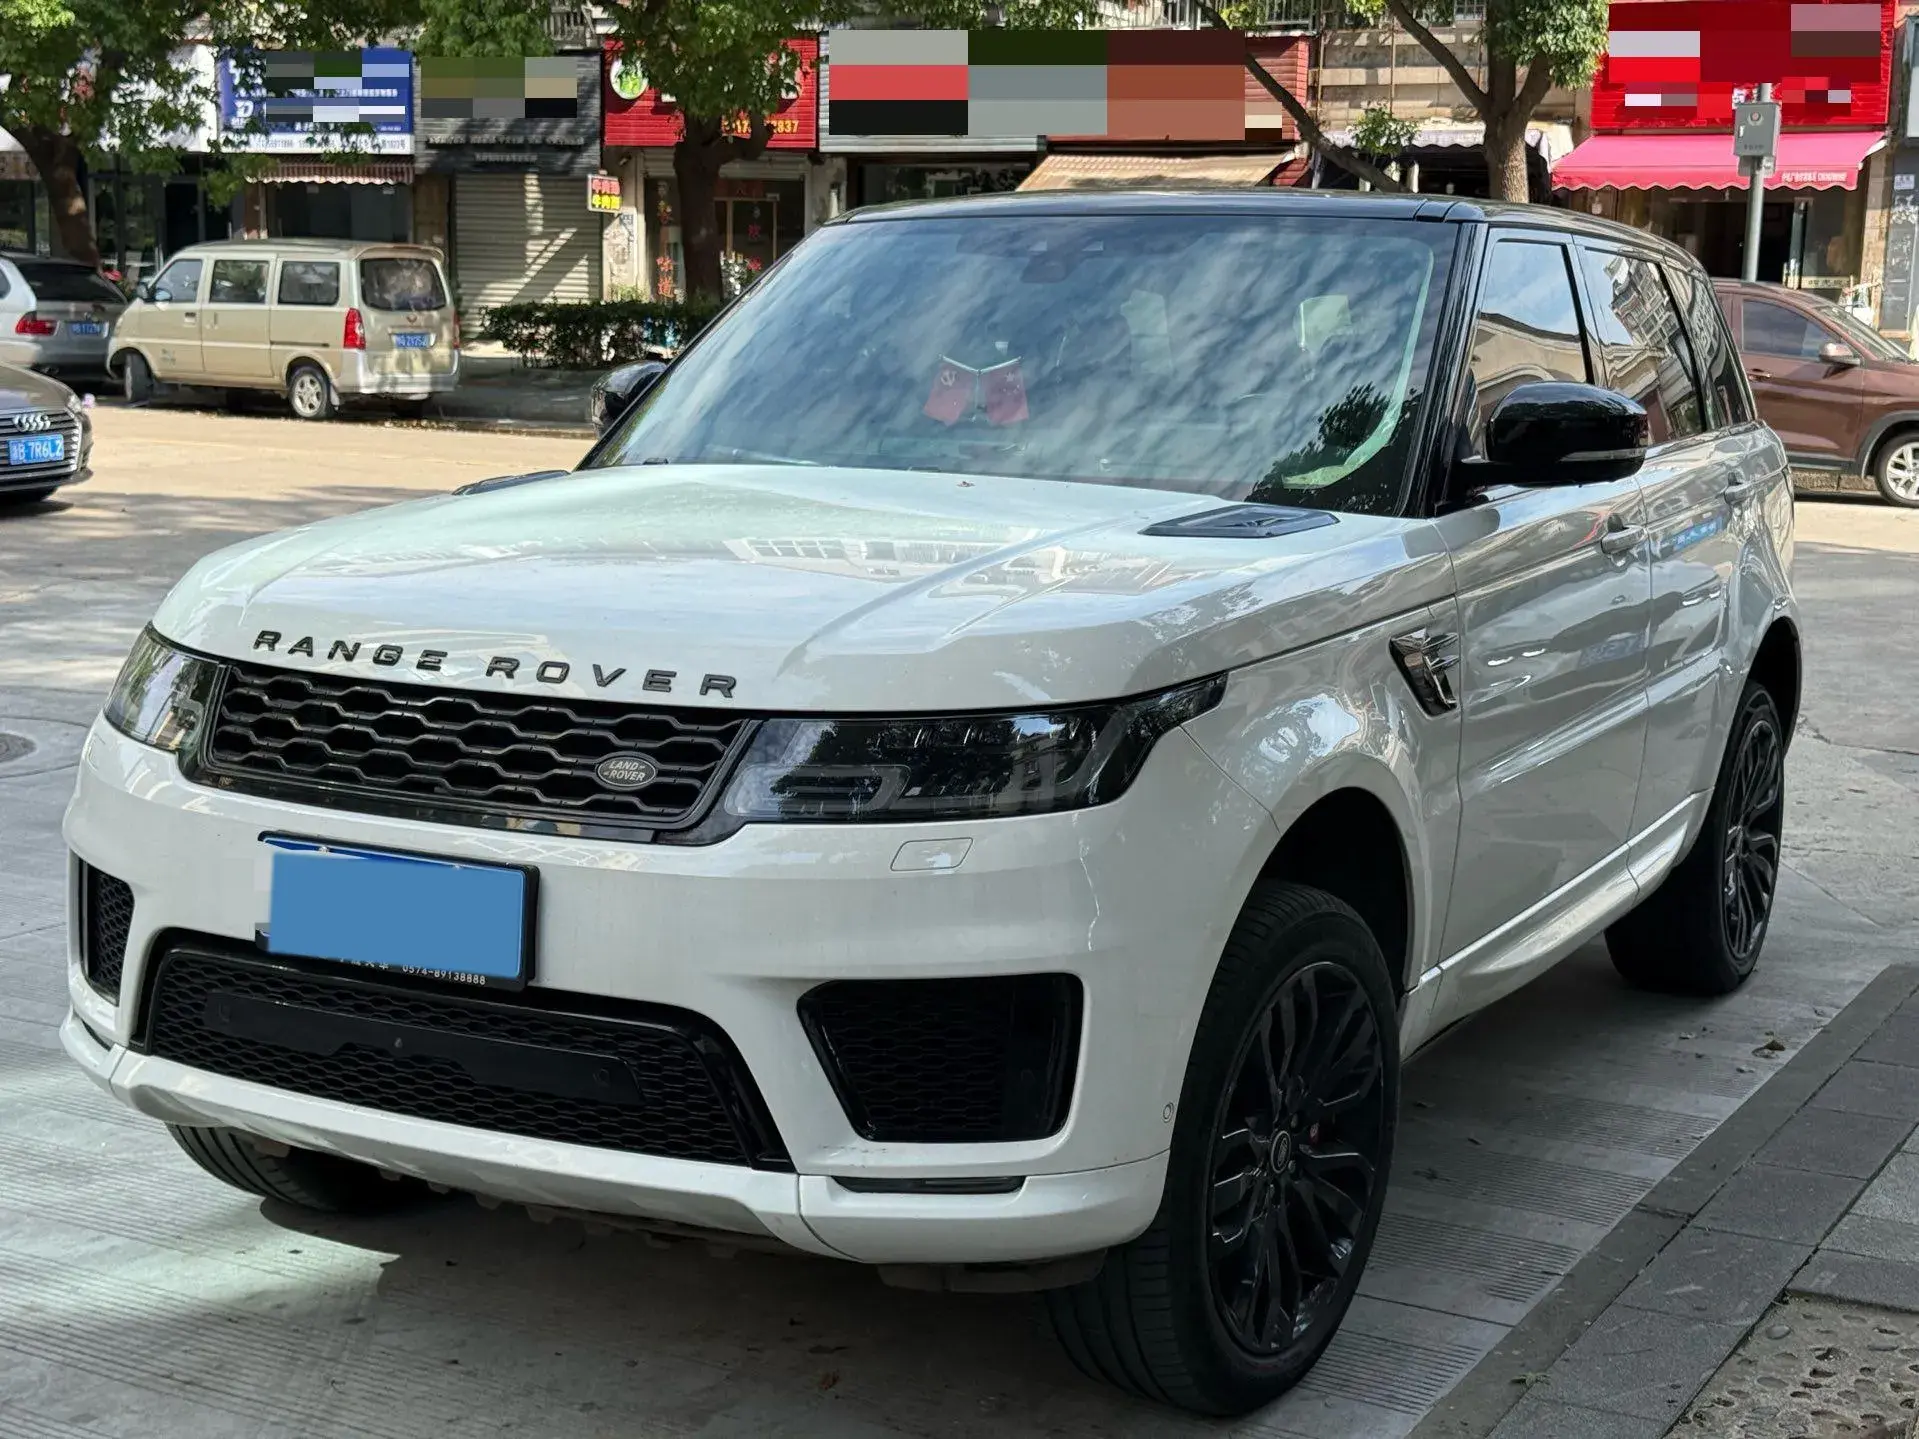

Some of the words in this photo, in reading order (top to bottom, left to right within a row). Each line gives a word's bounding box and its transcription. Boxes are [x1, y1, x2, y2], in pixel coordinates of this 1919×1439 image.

[253, 629, 448, 673] RANGE
[485, 656, 738, 699] ROVER
[608, 760, 639, 771] LAND
[608, 769, 646, 781] ROVER
[402, 963, 487, 986] 0574-89138888
